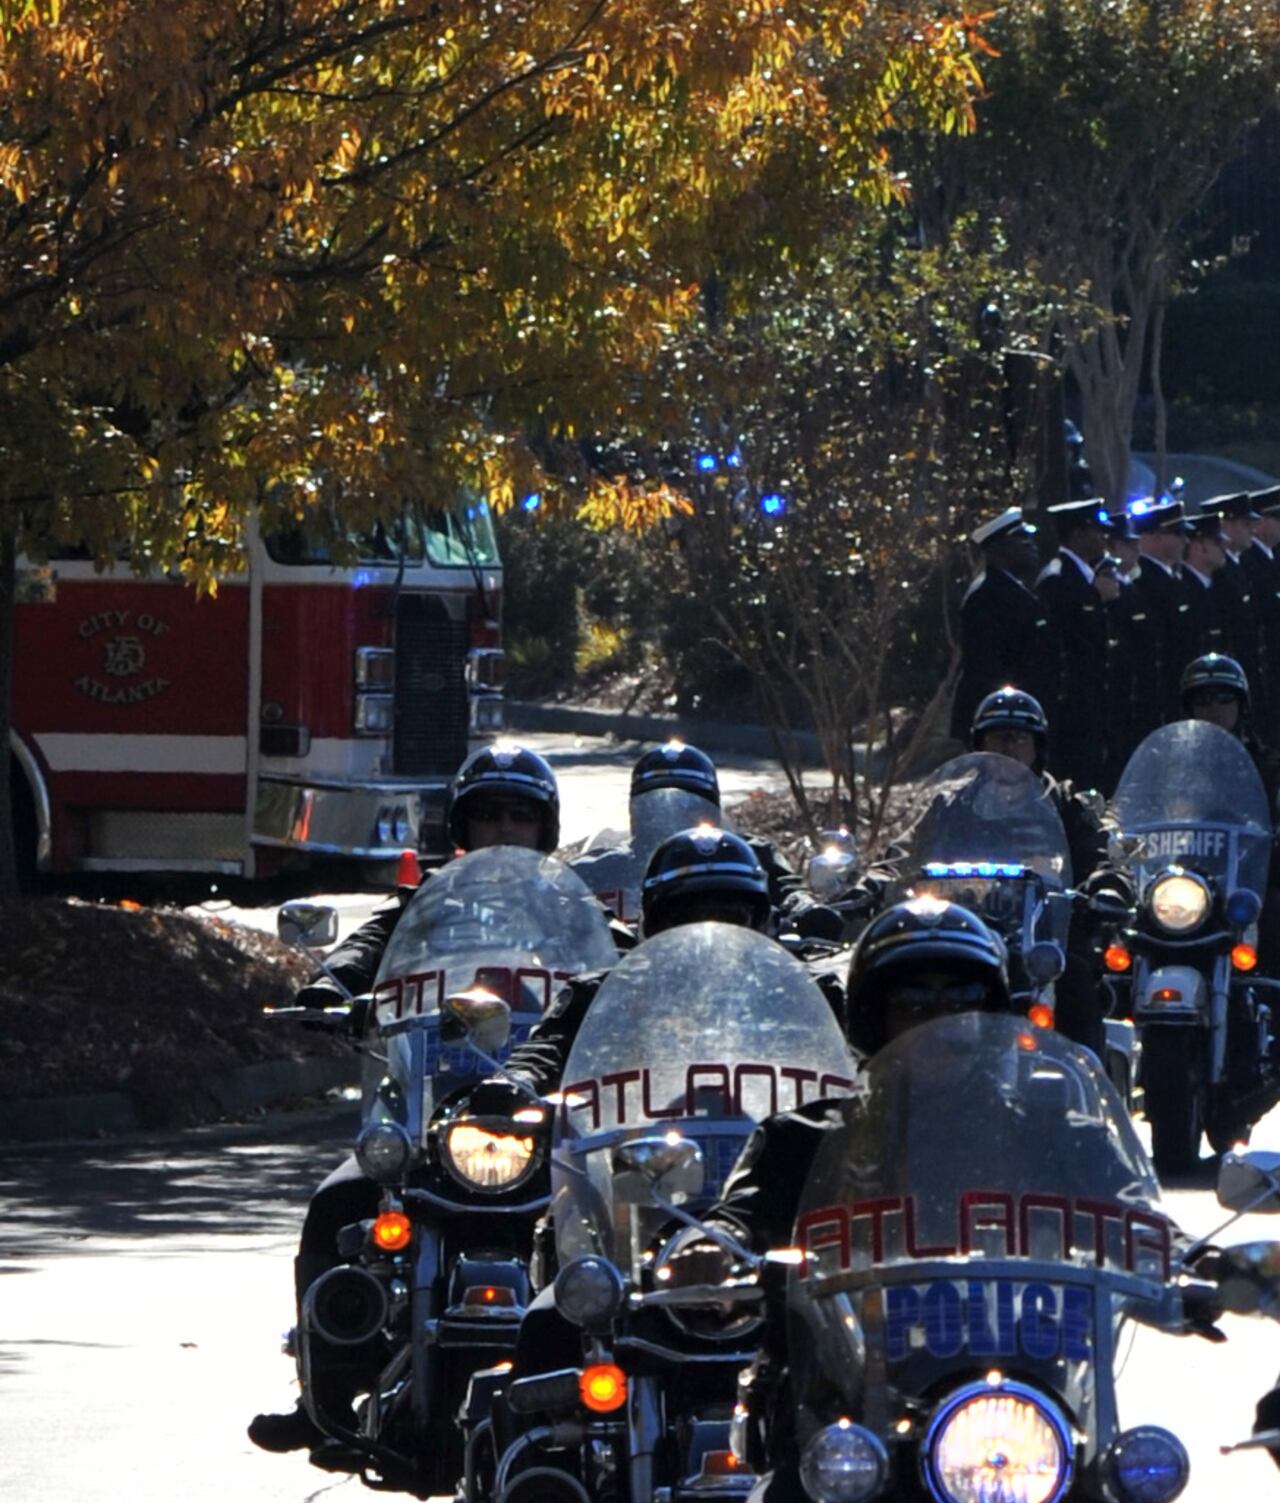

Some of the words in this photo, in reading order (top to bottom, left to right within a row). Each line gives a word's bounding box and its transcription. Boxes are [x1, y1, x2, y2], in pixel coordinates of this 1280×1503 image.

[79, 610, 130, 638] CITY
[137, 613, 171, 636] OF
[73, 676, 172, 703] ATLANTA
[1147, 830, 1226, 859] SHERIFF
[799, 1191, 1172, 1283] ATLANTA
[886, 1278, 1094, 1363] POLICE
